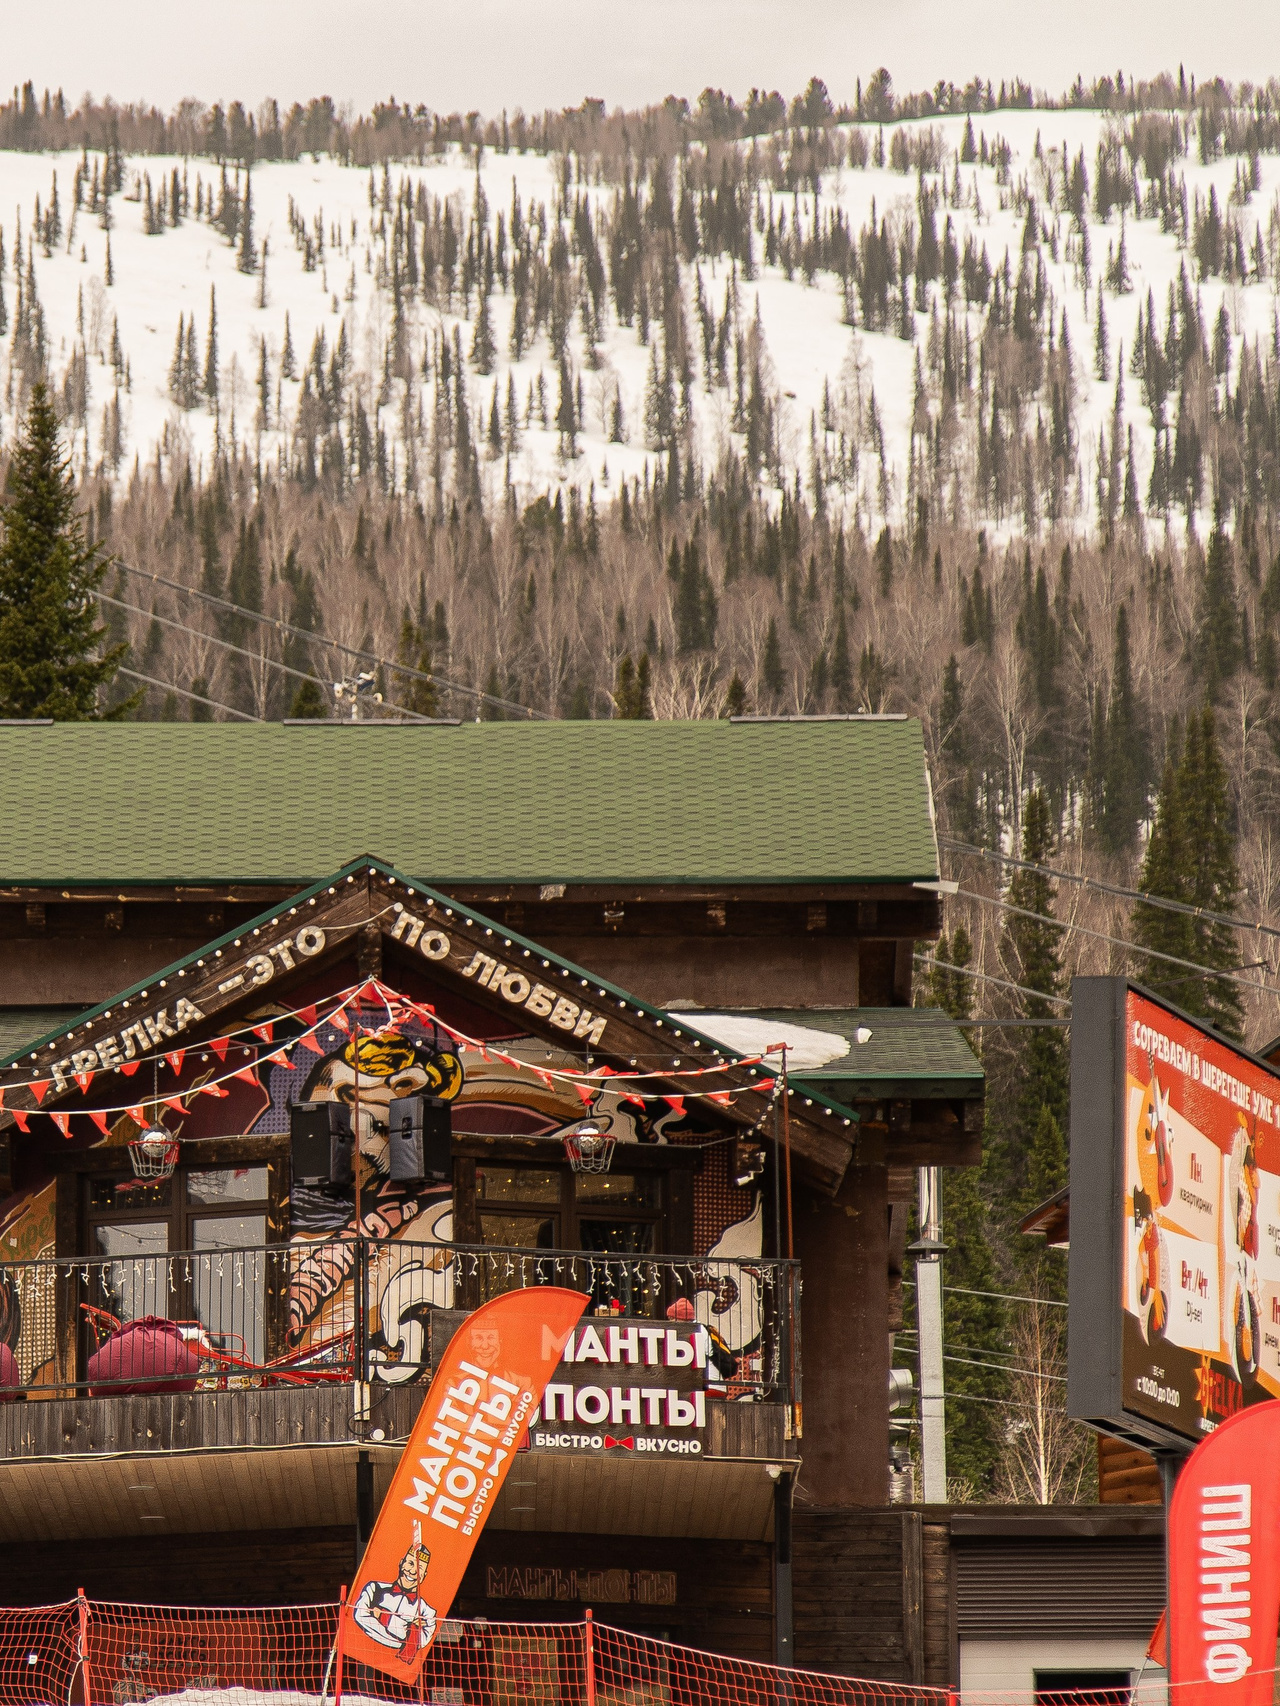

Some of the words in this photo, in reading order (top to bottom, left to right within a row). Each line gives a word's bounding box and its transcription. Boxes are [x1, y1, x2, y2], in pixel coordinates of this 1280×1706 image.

[50, 997, 205, 1093] ГРЕЛКА
[392, 908, 451, 961] ПО
[462, 951, 608, 1046] ЛЮБВИ
[1133, 1020, 1192, 1076] СОГРЕВАЕМ
[1192, 1053, 1200, 1080] В
[1201, 1060, 1251, 1110] ШЕРЕГЕШЕ
[1253, 1090, 1274, 1123] УЖЕ
[540, 1323, 707, 1369] МАНТЫ
[543, 1383, 706, 1428] ПОНТЫ
[404, 1360, 488, 1516] МАНТЫ
[431, 1374, 520, 1531] ПОНТЫ
[462, 1477, 494, 1536] БЫСТРО
[501, 1390, 533, 1447] ВКУСНО
[535, 1433, 604, 1449] БЫСТРО
[636, 1437, 701, 1454] ВКУСНО
[1201, 1484, 1253, 1683] ФИНИШ
